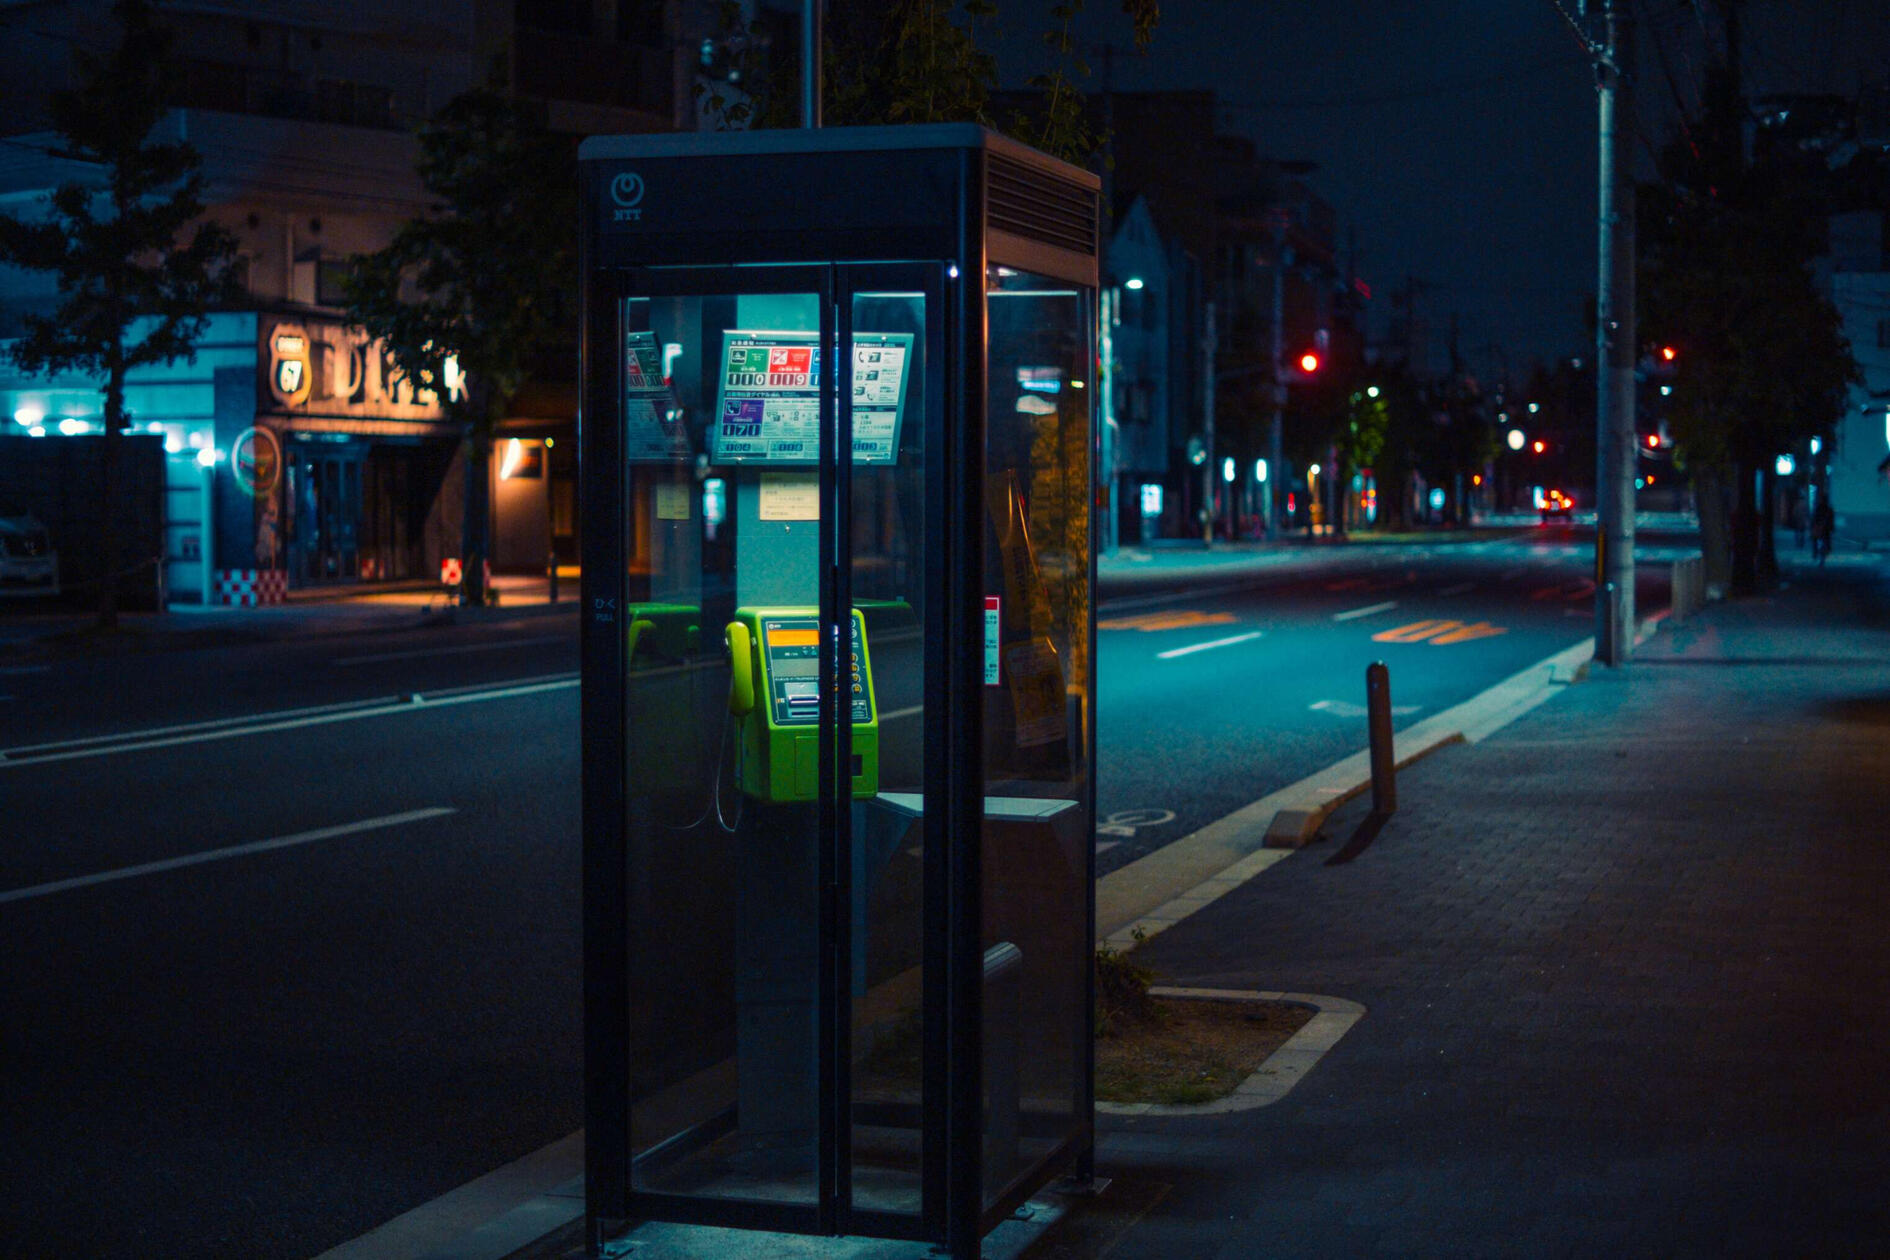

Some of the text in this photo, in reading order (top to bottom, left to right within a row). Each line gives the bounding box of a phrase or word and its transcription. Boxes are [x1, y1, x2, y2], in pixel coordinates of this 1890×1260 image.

[614, 209, 642, 220] NTT
[731, 374, 765, 386] 110
[771, 374, 806, 386] 119
[724, 425, 758, 436] 171
